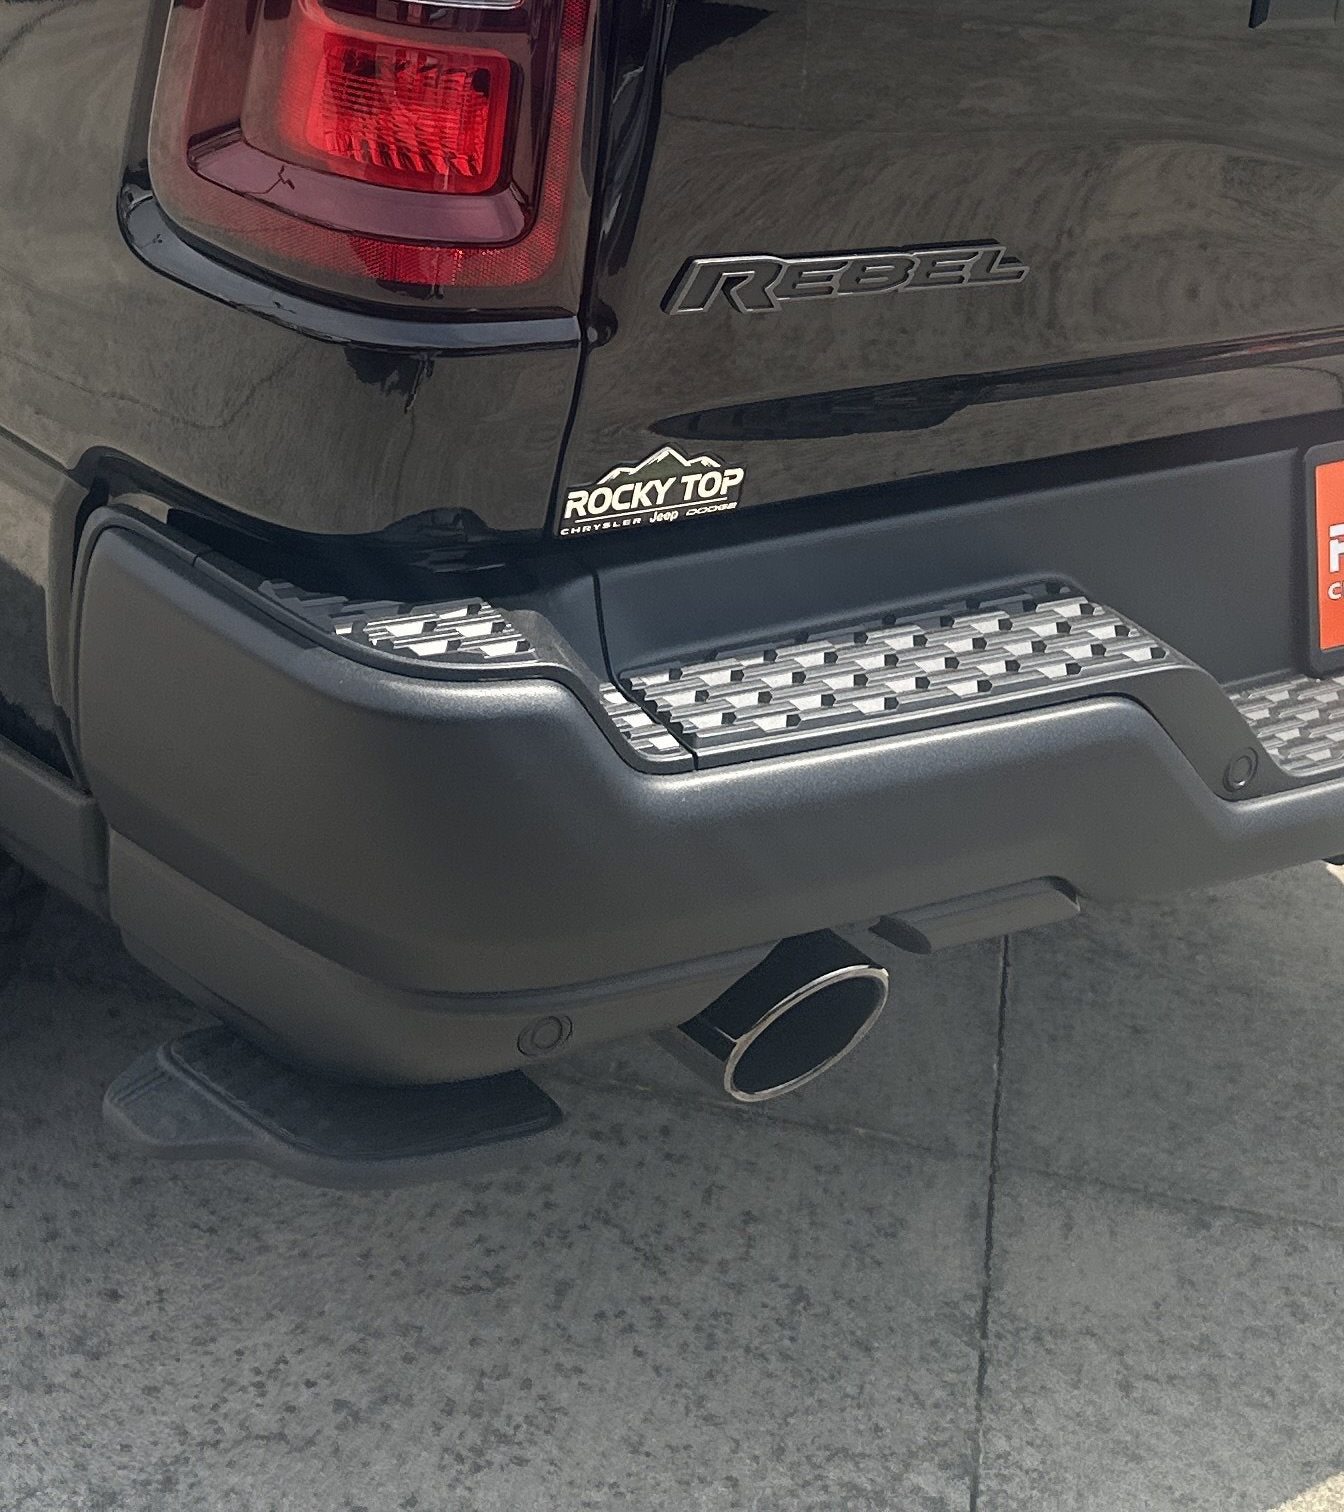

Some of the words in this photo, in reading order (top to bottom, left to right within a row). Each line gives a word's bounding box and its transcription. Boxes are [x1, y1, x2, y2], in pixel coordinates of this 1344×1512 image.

[660, 238, 1030, 316] REBEL
[564, 477, 676, 519] ROCKY
[681, 467, 745, 501] TOP
[560, 518, 641, 536] CHRYSLER
[649, 510, 679, 524] Jeep
